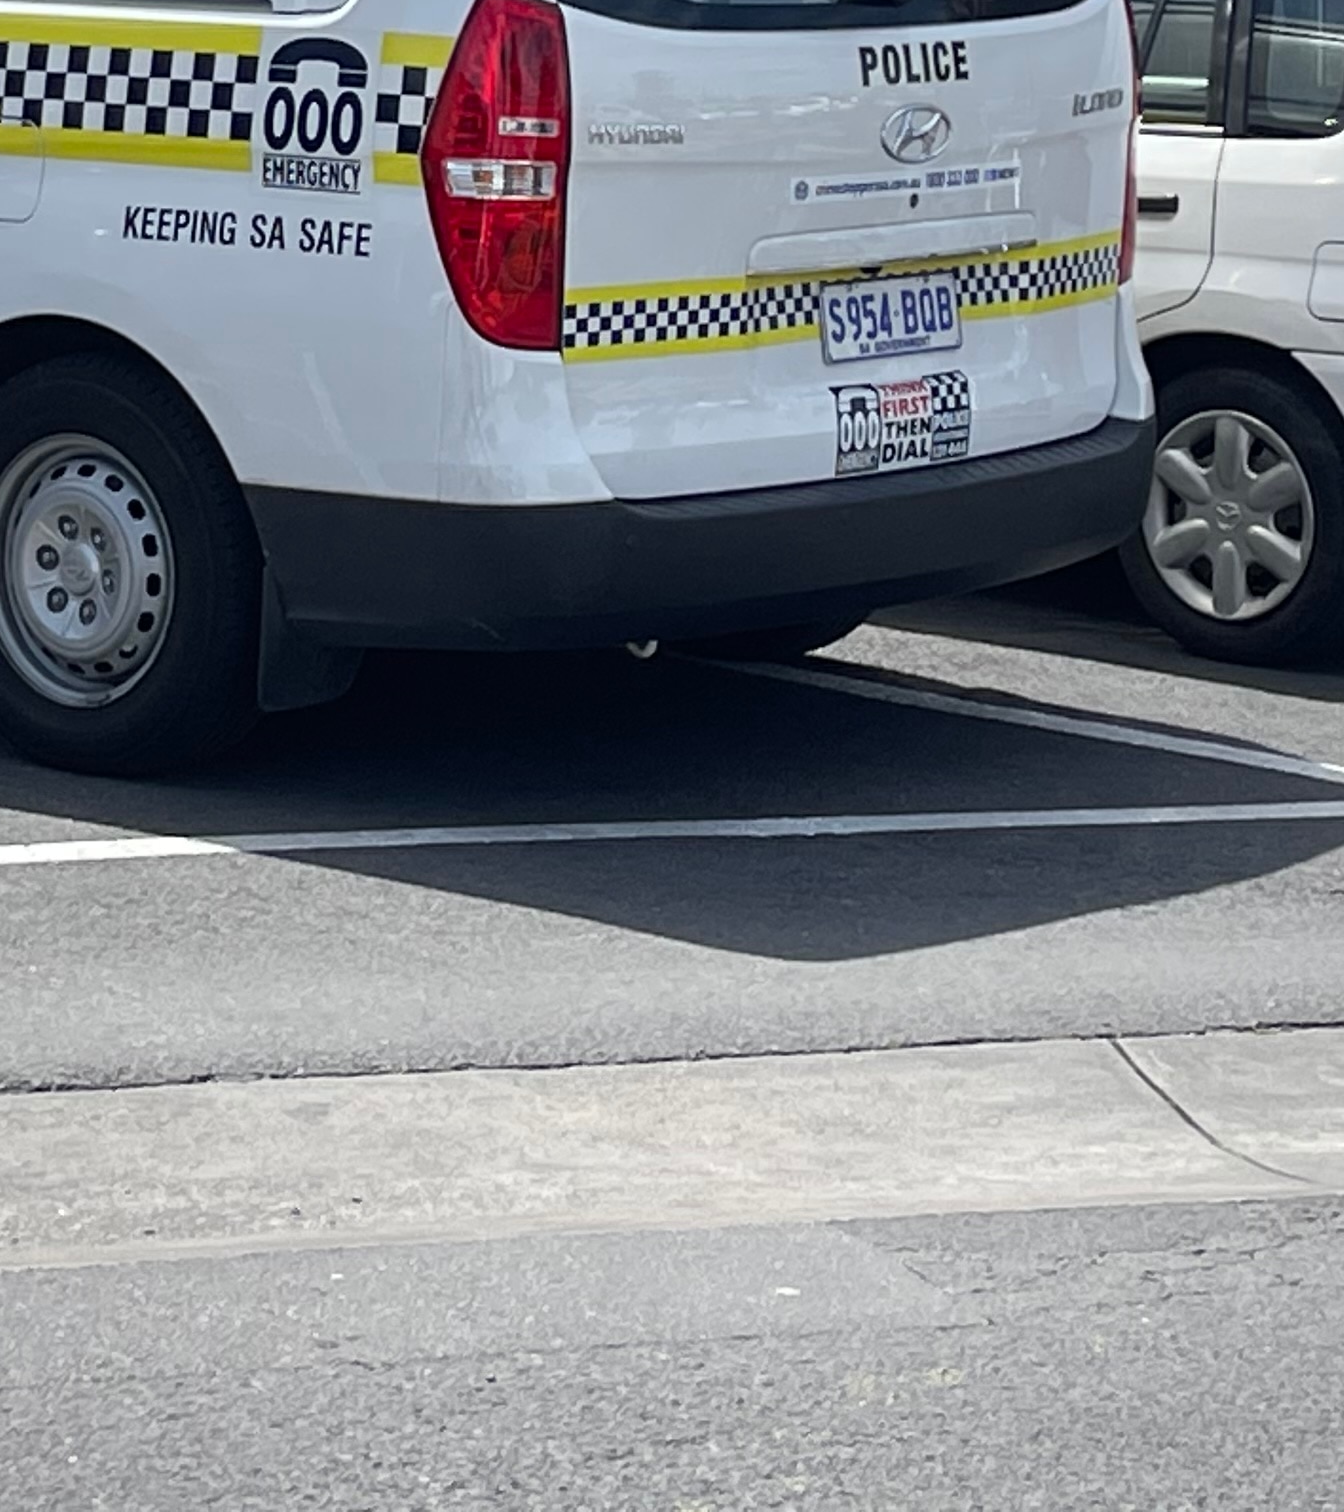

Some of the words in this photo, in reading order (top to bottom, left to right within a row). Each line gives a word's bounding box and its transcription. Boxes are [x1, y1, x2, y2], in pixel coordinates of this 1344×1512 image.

[858, 40, 970, 88] POLICE
[263, 86, 363, 156] 000
[262, 159, 361, 191] EMERGENCY
[122, 205, 237, 246] KEEPING
[250, 213, 286, 250] SA
[299, 217, 373, 258] SAFE
[882, 396, 930, 419] FIRST
[840, 410, 880, 453] 000
[884, 416, 933, 440] THEN
[881, 439, 929, 464] DIAL
